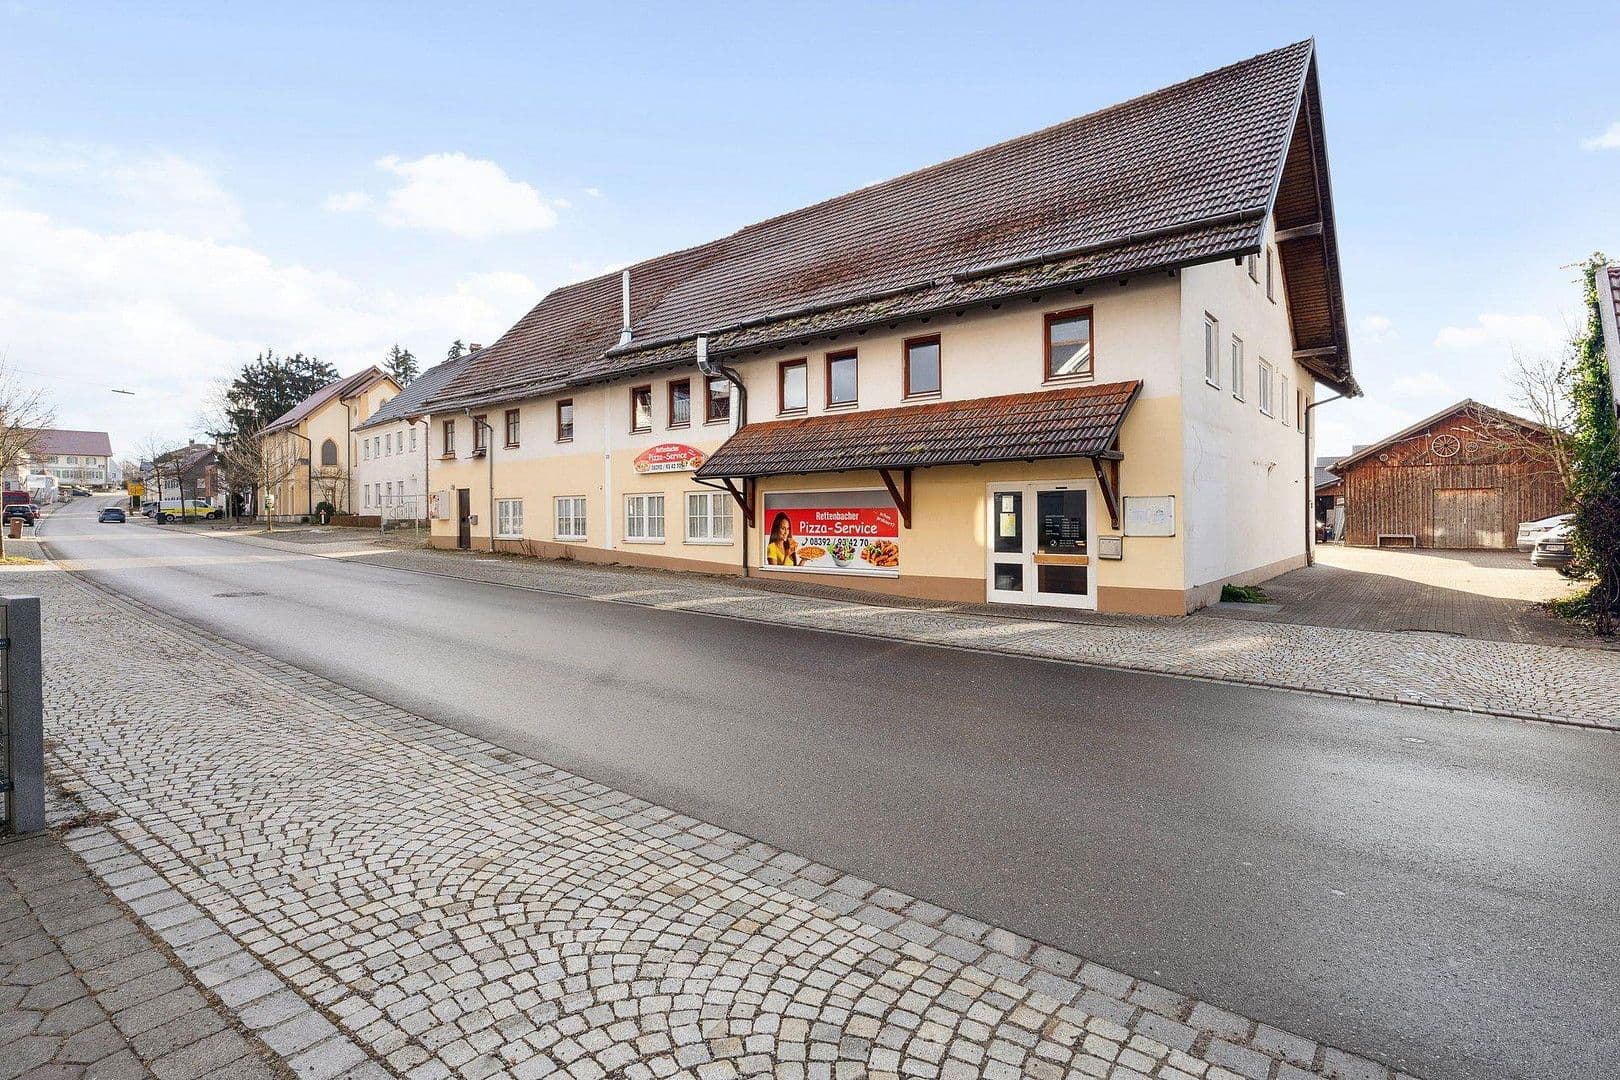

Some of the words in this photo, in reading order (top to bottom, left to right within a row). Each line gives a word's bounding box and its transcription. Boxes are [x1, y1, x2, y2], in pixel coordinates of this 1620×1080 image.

[815, 511, 859, 520] Rettenbacher
[799, 520, 878, 534] Pizza-Service
[809, 538, 831, 546] 08392
[837, 538, 847, 546] 93
[848, 538, 858, 546] 42
[859, 538, 869, 547] 70
